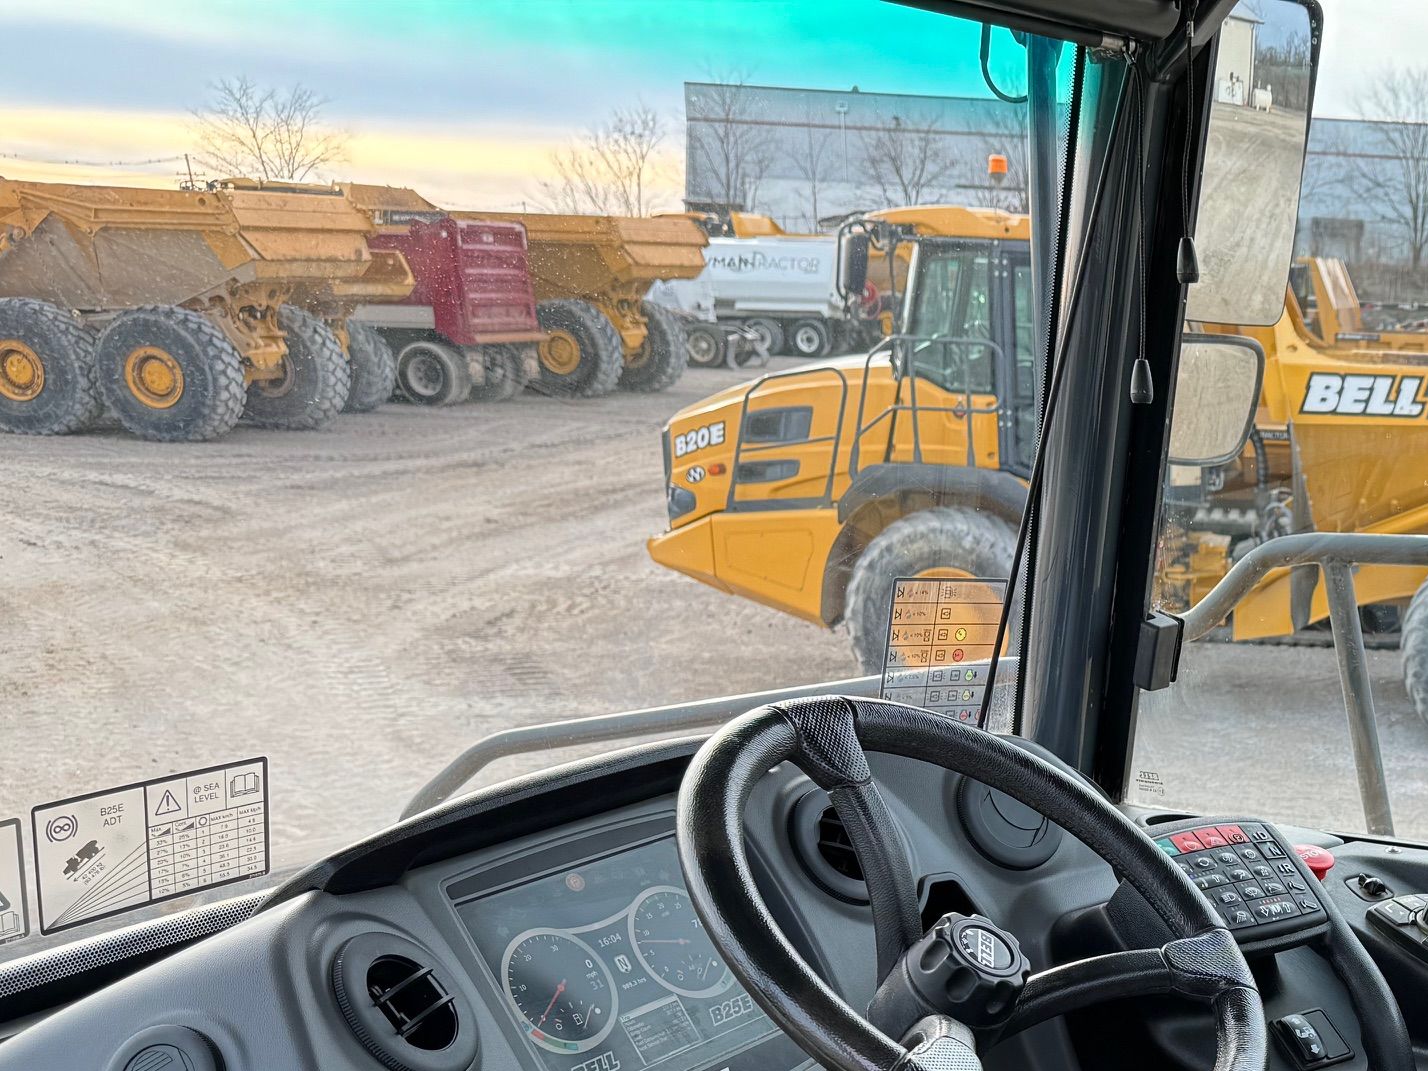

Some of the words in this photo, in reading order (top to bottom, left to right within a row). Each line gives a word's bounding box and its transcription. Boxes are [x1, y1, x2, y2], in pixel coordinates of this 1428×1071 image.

[1301, 373, 1424, 416] BELL
[675, 421, 725, 458] B20E
[193, 786, 201, 795] @
[204, 782, 220, 791] SEA
[194, 792, 220, 803] LEVEL
[100, 803, 124, 816] B25E
[103, 815, 122, 827] ADT
[1259, 832, 1268, 840] D
[1269, 846, 1282, 856] N
[1286, 863, 1295, 873] R
[598, 932, 622, 948] 16:04
[978, 928, 995, 969] BELL
[709, 993, 753, 1027] B25E
